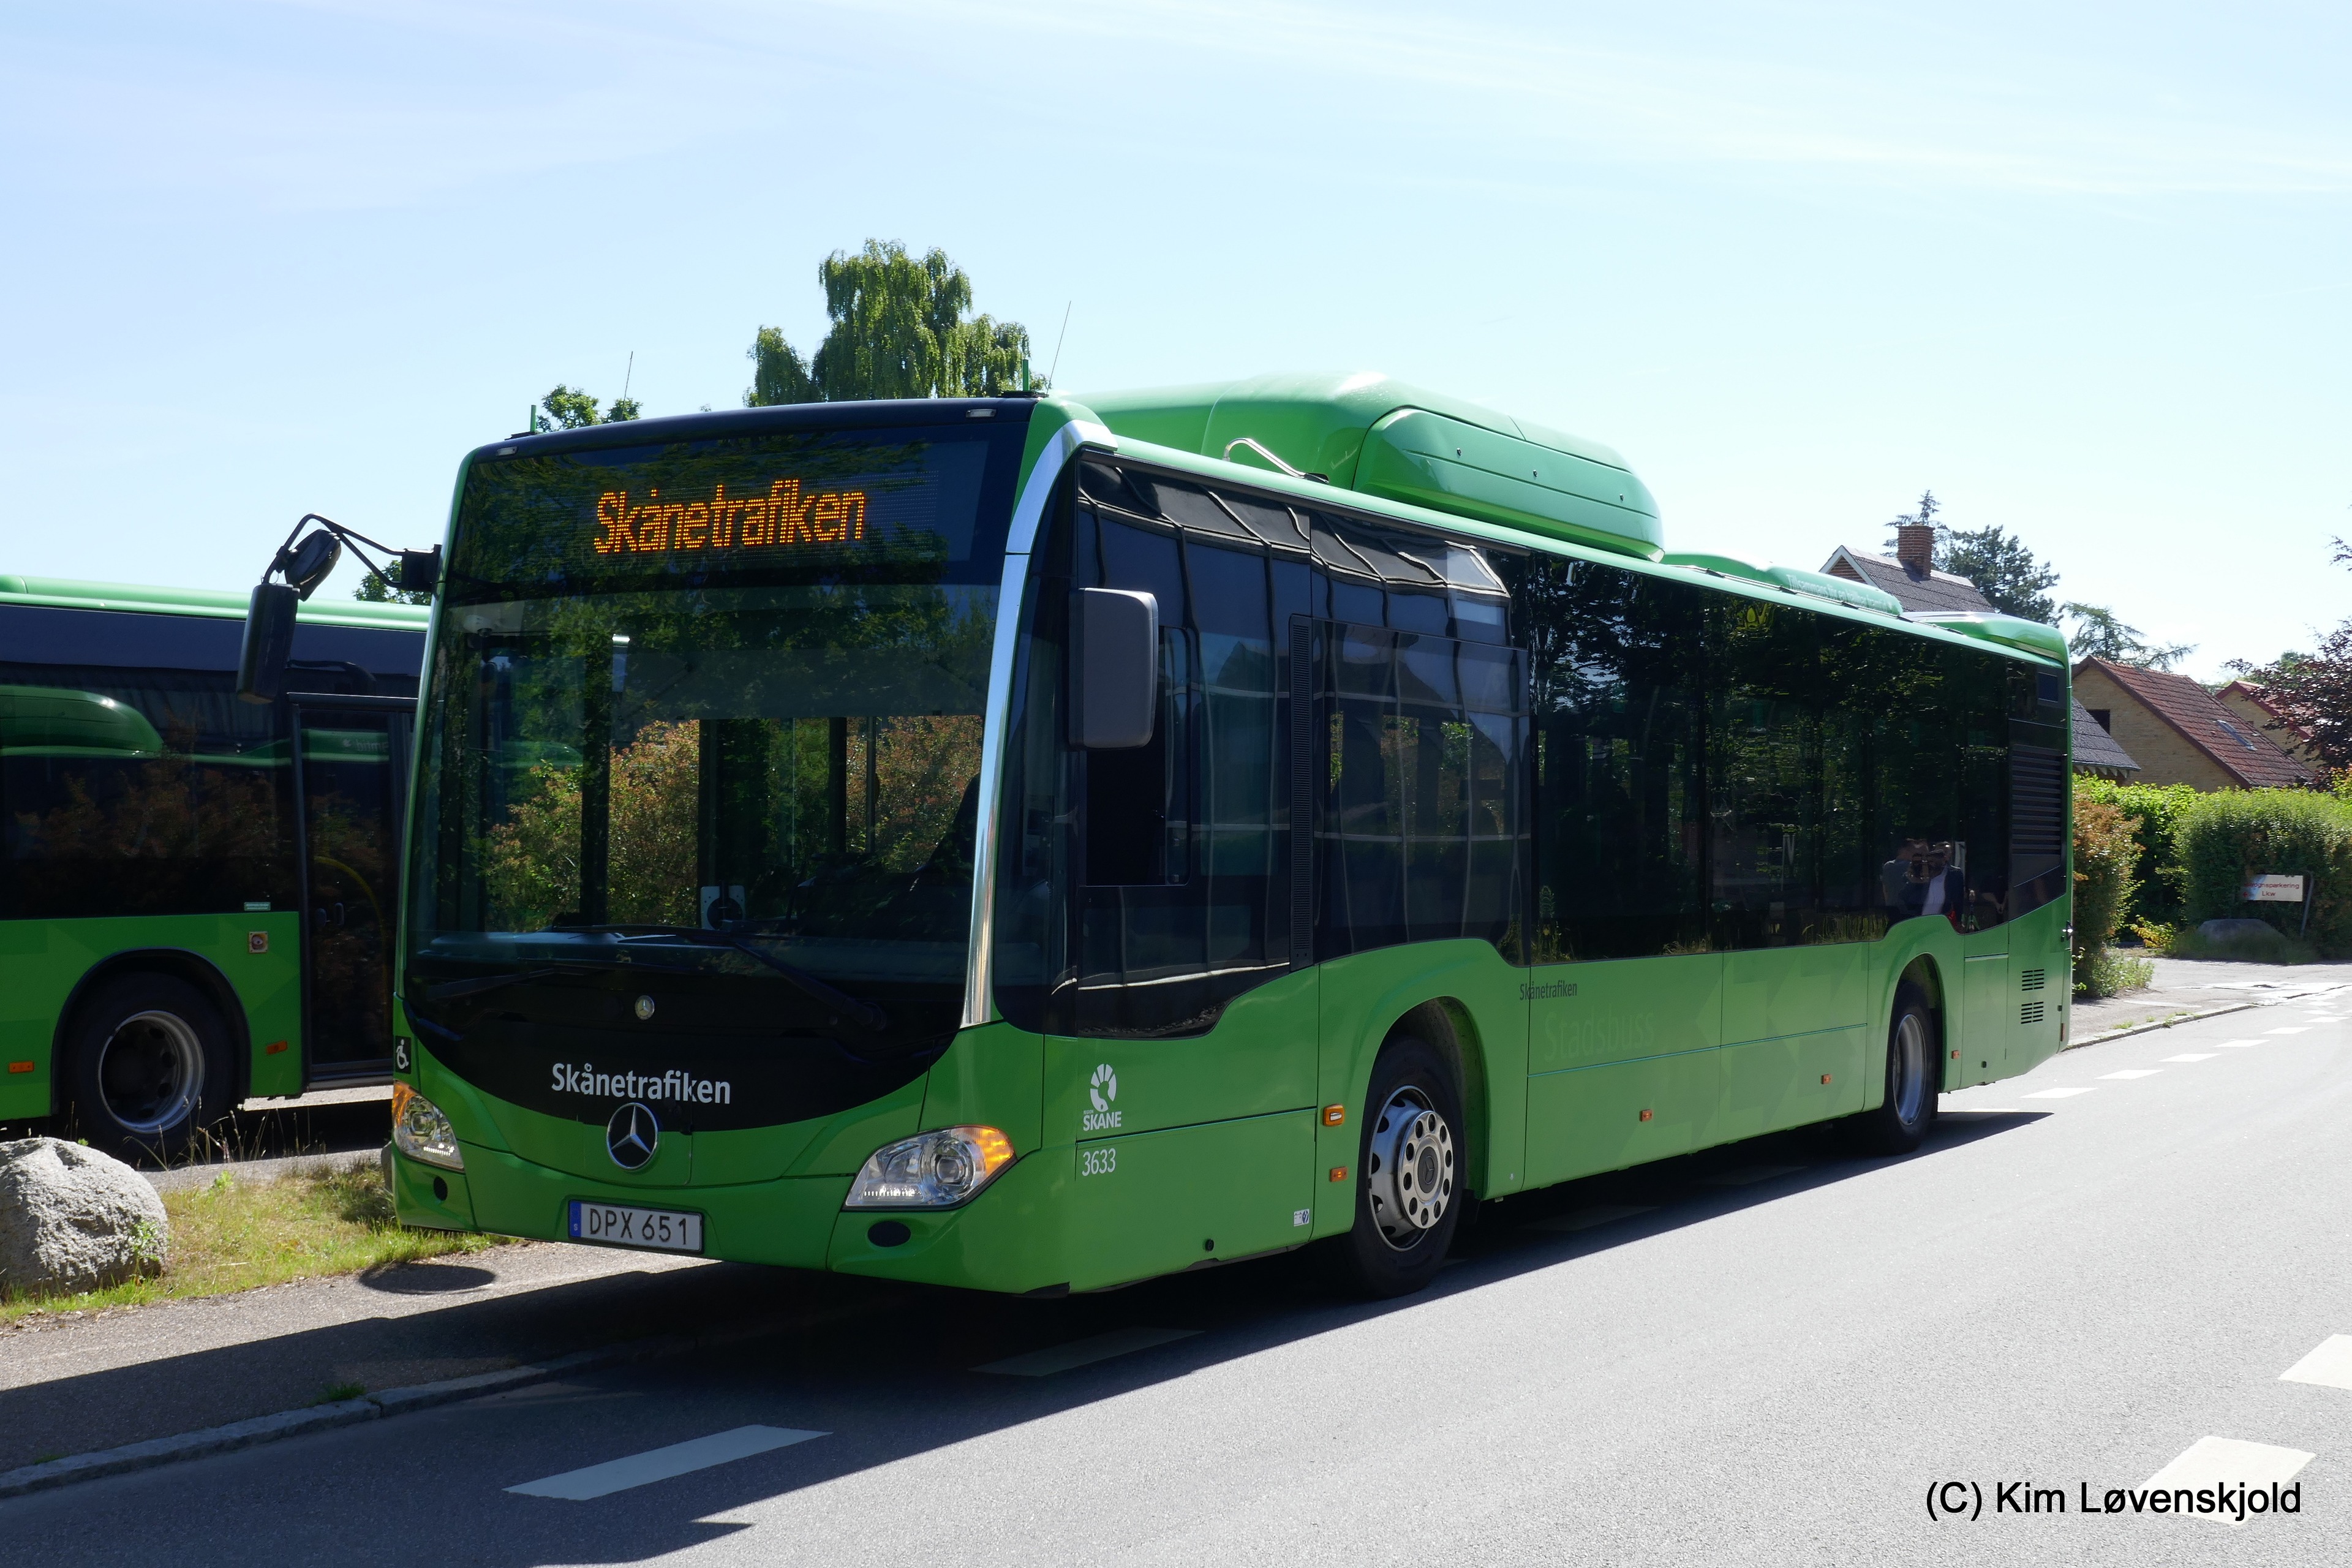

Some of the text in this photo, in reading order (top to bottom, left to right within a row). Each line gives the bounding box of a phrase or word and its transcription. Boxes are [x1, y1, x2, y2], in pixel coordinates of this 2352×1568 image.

[594, 478, 867, 554] Skånetrafiken
[1520, 980, 1577, 1001] Skånetrafiken
[1544, 1003, 1657, 1062] Stadsbuss
[551, 1063, 731, 1104] Skånetrafiken
[1082, 1148, 1116, 1177] 3633
[590, 1208, 633, 1238] DPX
[642, 1215, 687, 1245] 651
